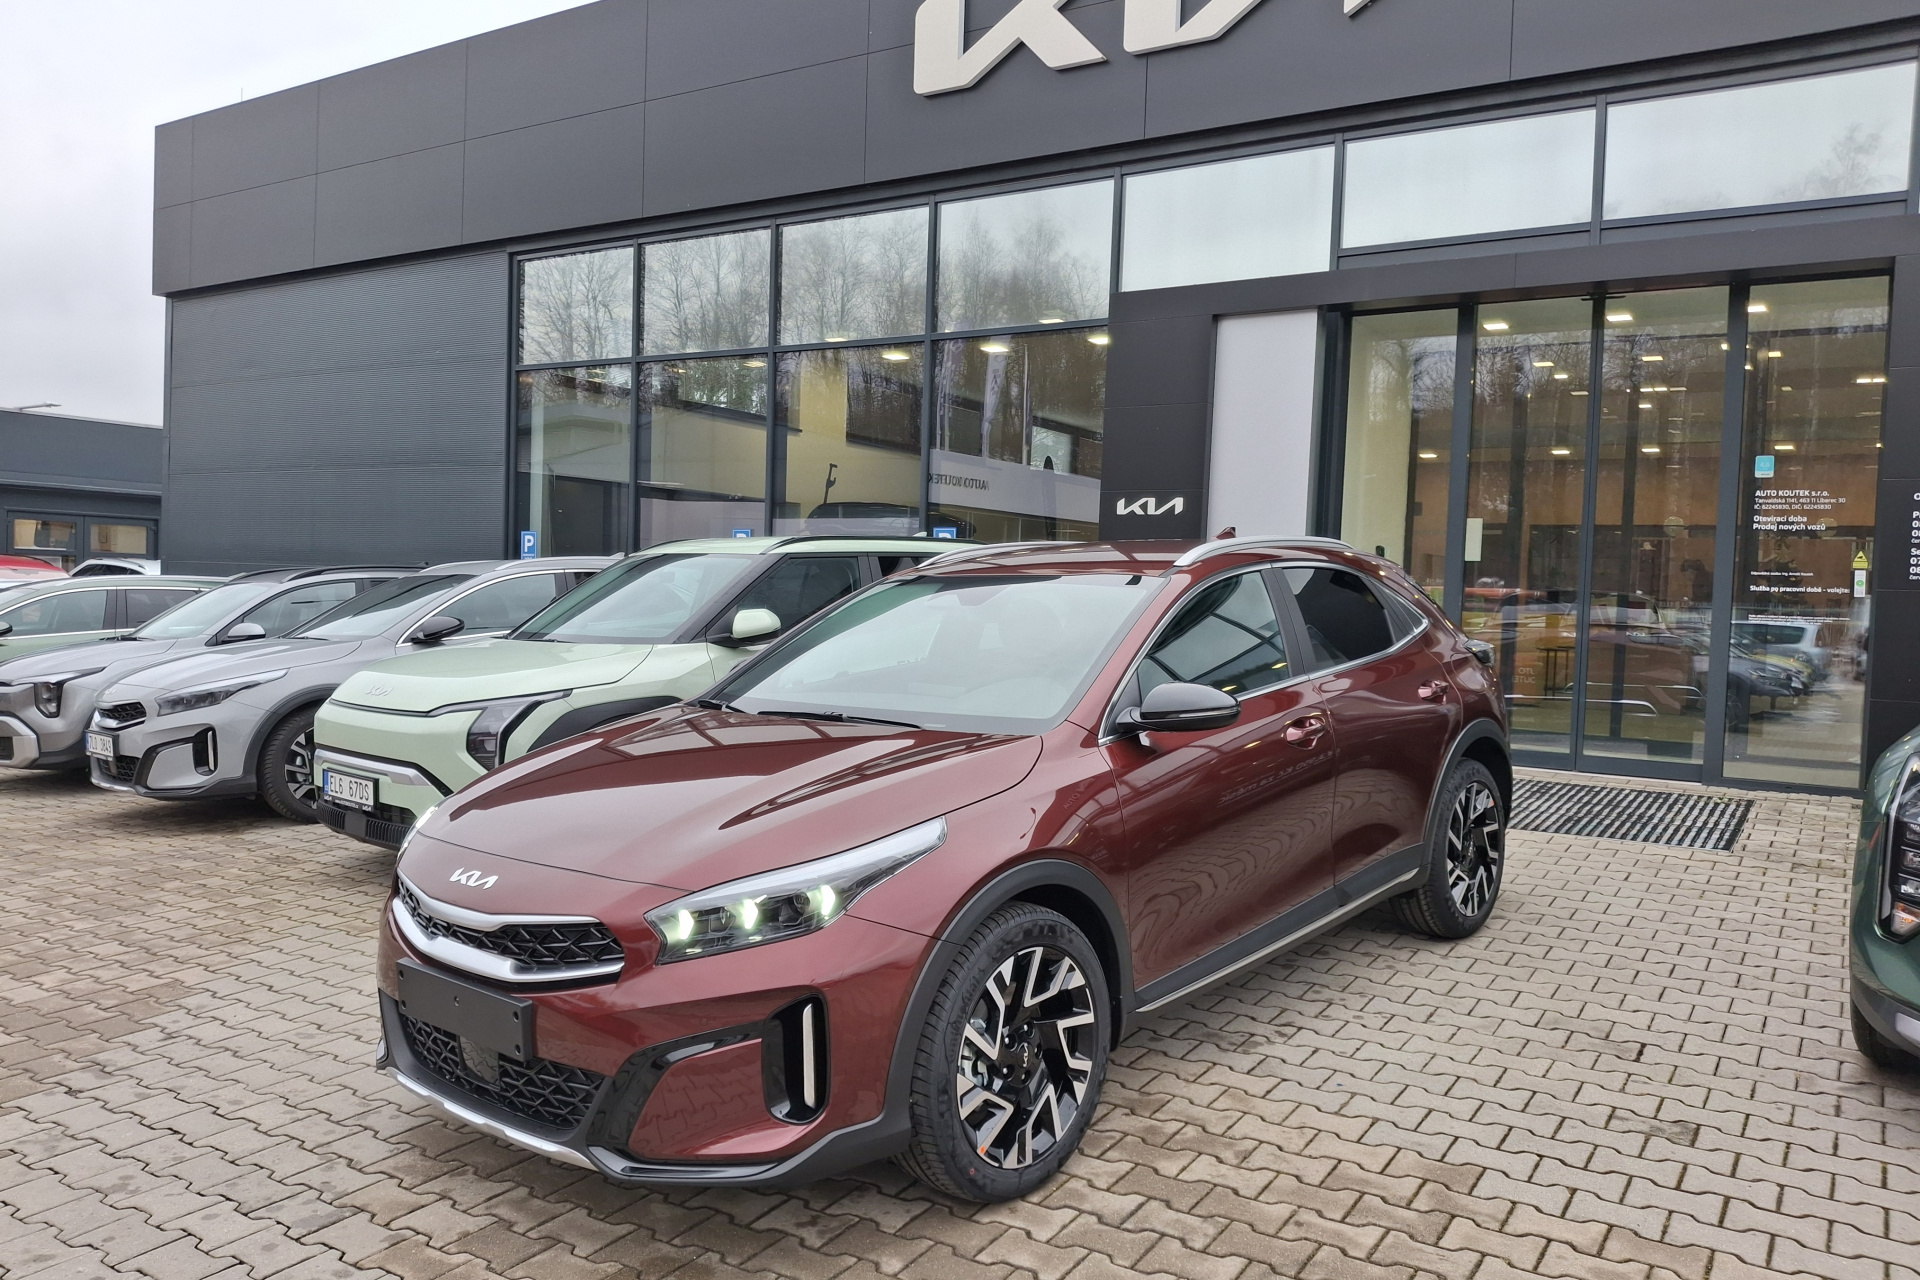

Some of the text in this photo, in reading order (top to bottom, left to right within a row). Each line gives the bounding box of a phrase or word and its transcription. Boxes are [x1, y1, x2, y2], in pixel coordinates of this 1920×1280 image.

[1117, 497, 1183, 515] KIA
[1753, 524, 1778, 532] Prodej
[330, 775, 343, 794] EL6
[449, 867, 499, 890] KIA
